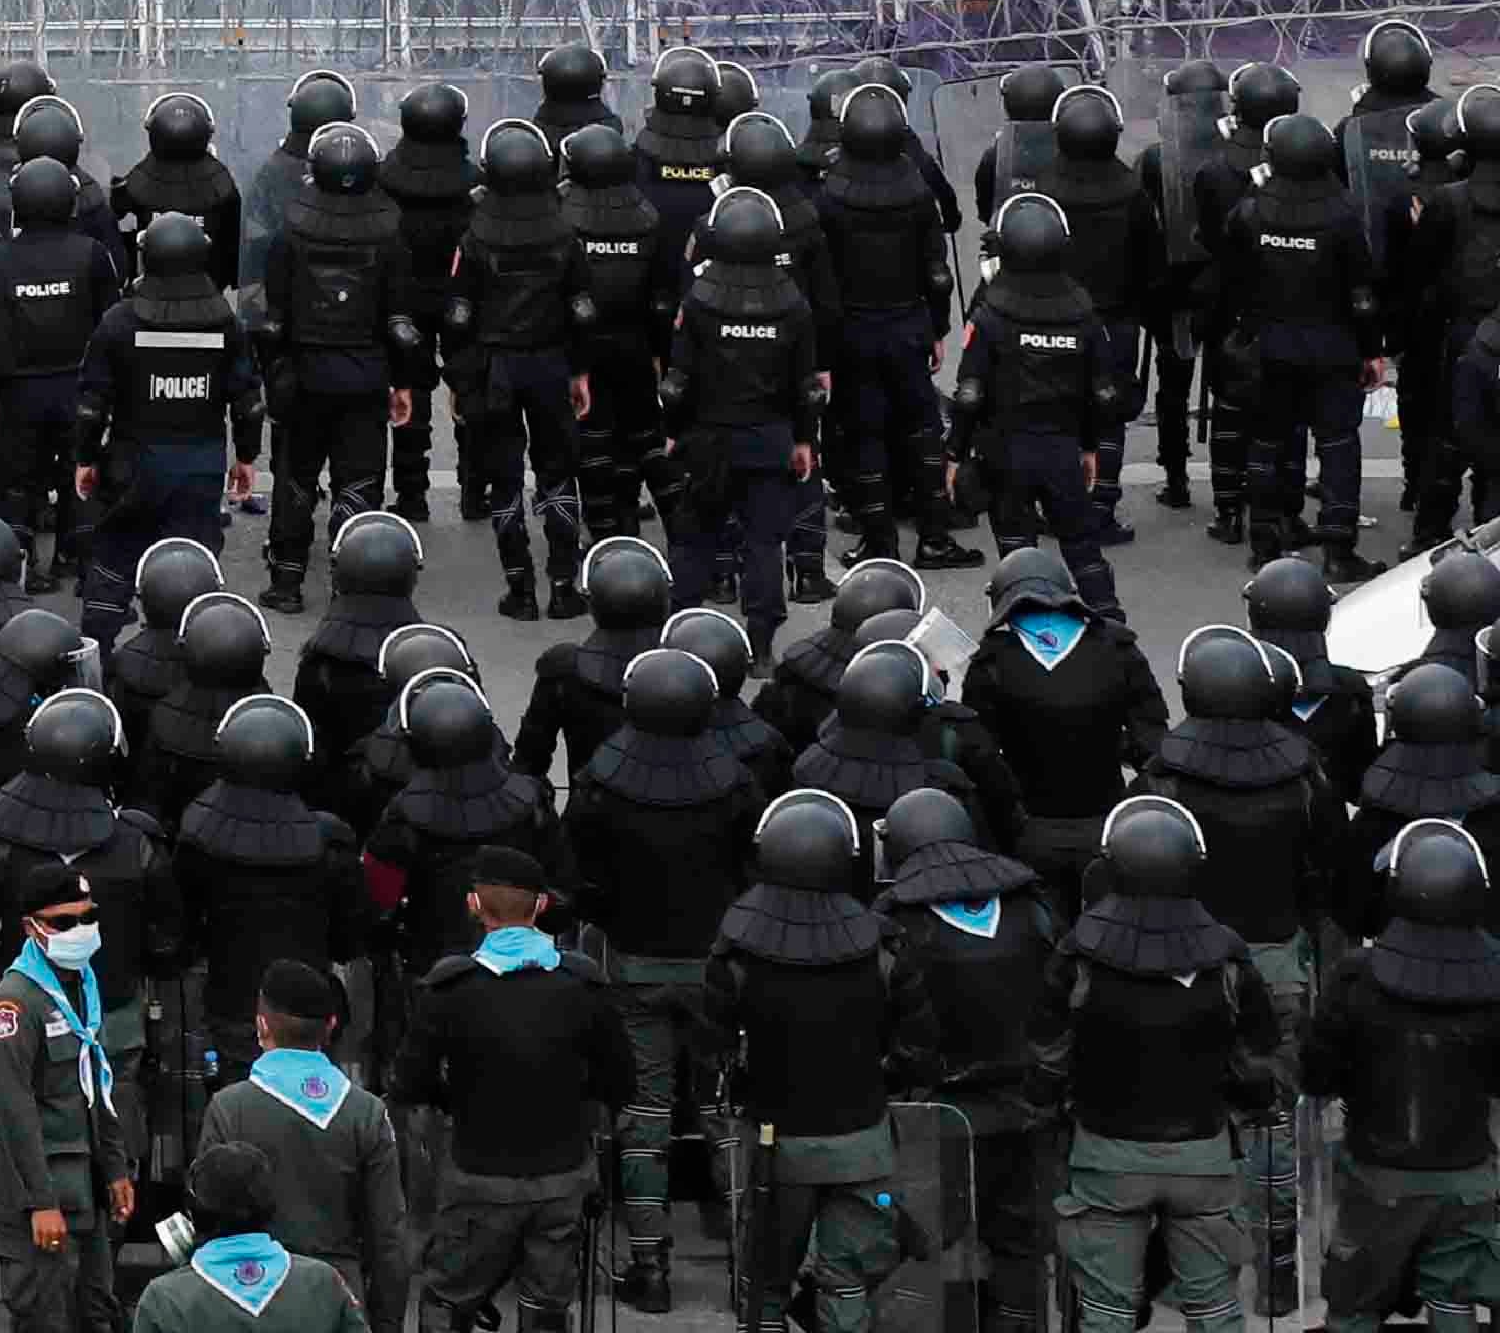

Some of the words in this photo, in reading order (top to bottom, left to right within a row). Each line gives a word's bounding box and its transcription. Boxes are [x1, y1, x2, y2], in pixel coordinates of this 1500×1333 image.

[661, 164, 711, 181] POLICE
[586, 241, 639, 255] POLICE
[1260, 233, 1317, 251] POLICE
[15, 281, 71, 297] POLICE
[721, 324, 777, 339] POLICE
[1019, 333, 1077, 349] POLICE
[154, 375, 206, 400] POLICE
